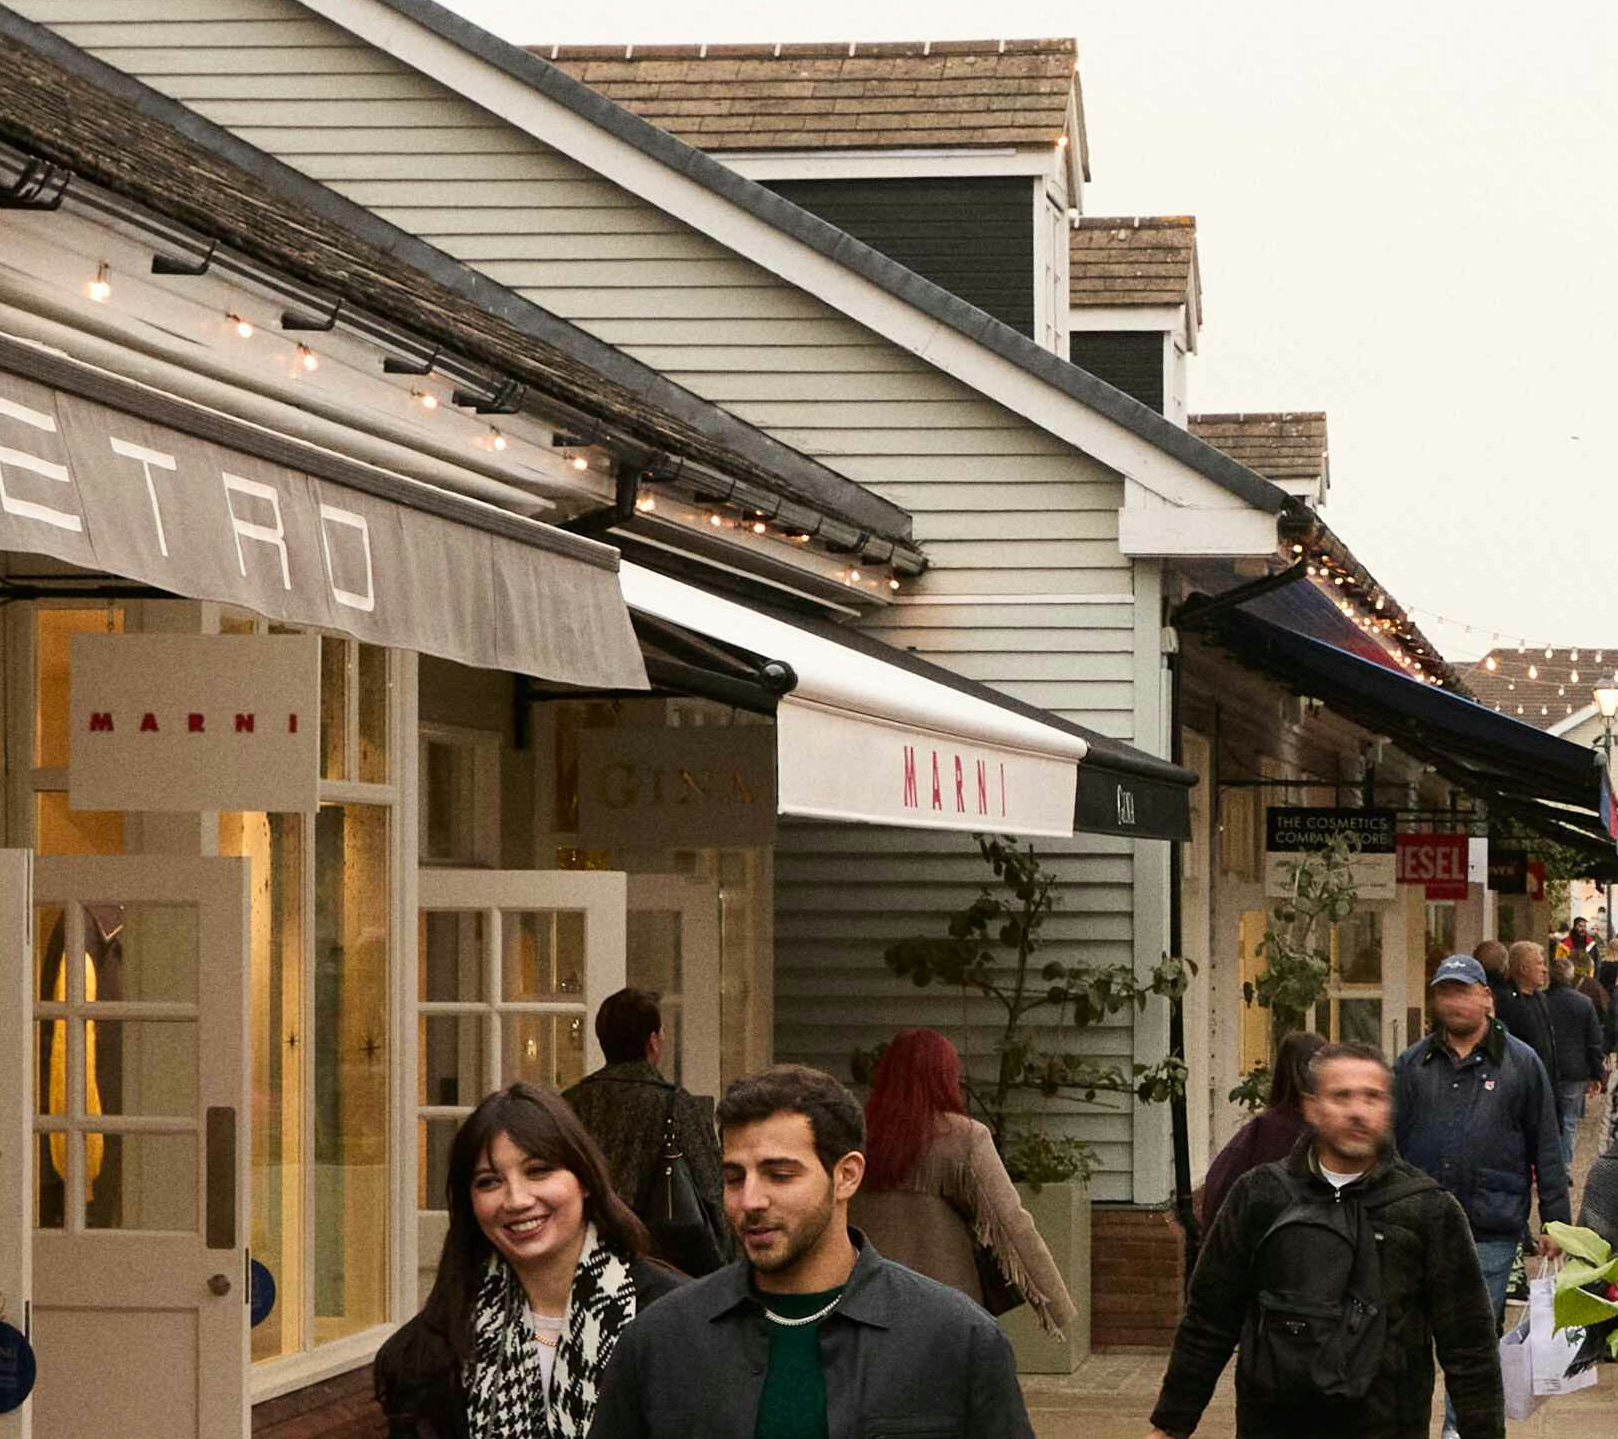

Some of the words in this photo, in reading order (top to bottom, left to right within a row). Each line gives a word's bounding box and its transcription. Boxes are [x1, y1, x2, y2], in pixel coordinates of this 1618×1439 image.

[89, 713, 298, 734] MARNI
[904, 745, 1007, 818] MARNI
[1277, 817, 1302, 829] THE
[1306, 817, 1389, 830] COSMETICS
